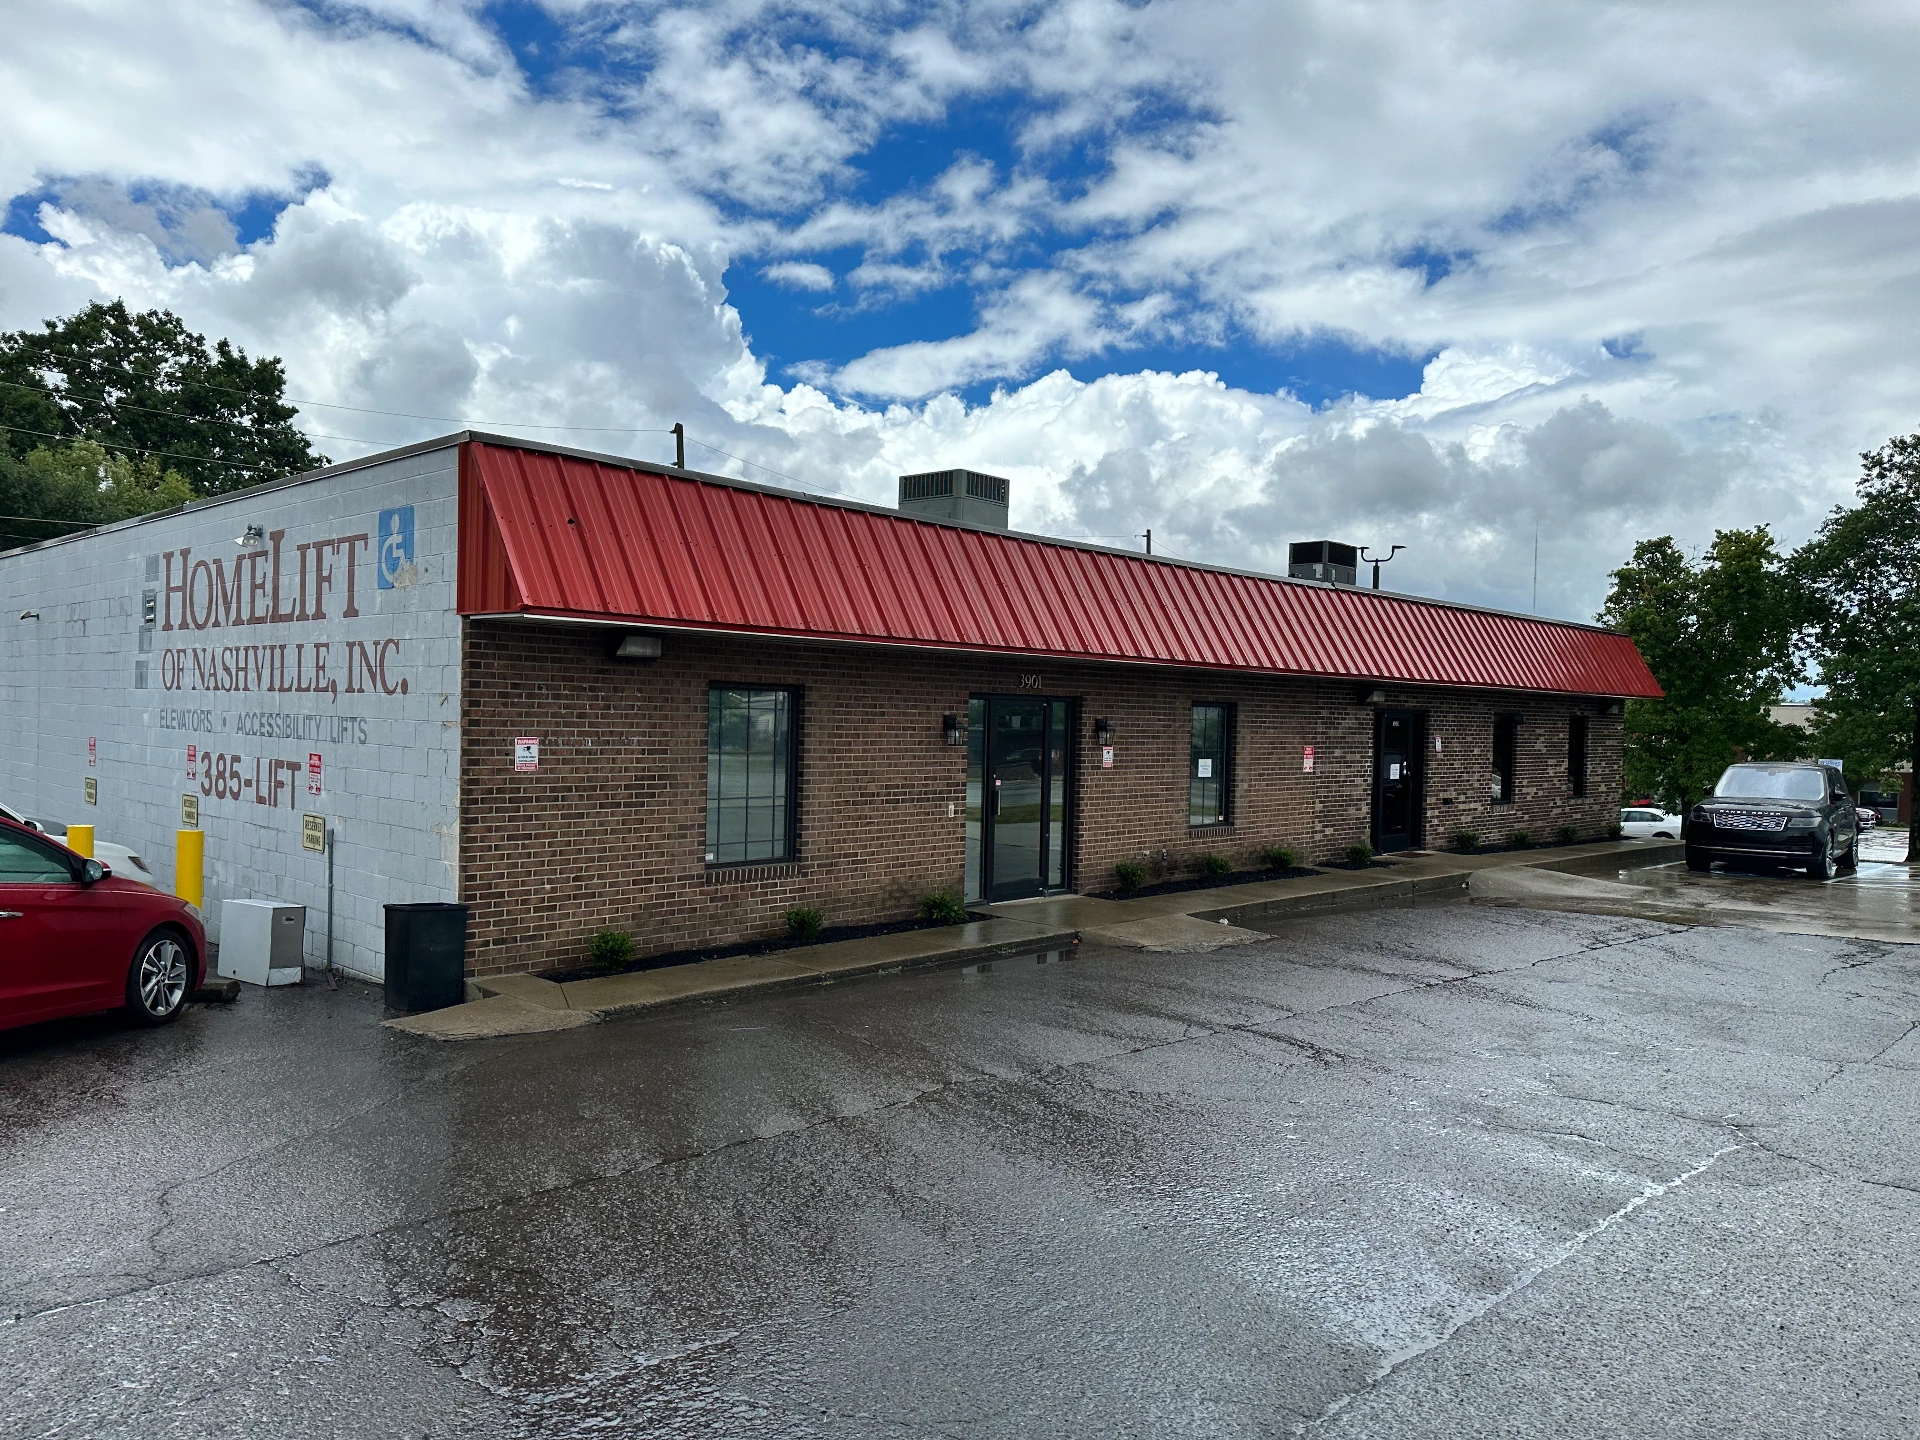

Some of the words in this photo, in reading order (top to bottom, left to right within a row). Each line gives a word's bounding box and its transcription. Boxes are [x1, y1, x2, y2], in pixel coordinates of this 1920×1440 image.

[161, 648, 187, 692] OF
[191, 642, 338, 705] NASHVILLE,
[344, 638, 409, 696] INC.
[1018, 673, 1043, 689] 3901
[159, 708, 213, 733] ELEVATORS
[236, 711, 322, 742] ACCESSIBILITY
[329, 716, 368, 745] LIFTS
[200, 751, 302, 811] 385-LIFT
[304, 819, 322, 833] RESERVED
[305, 833, 321, 846] PARKING
